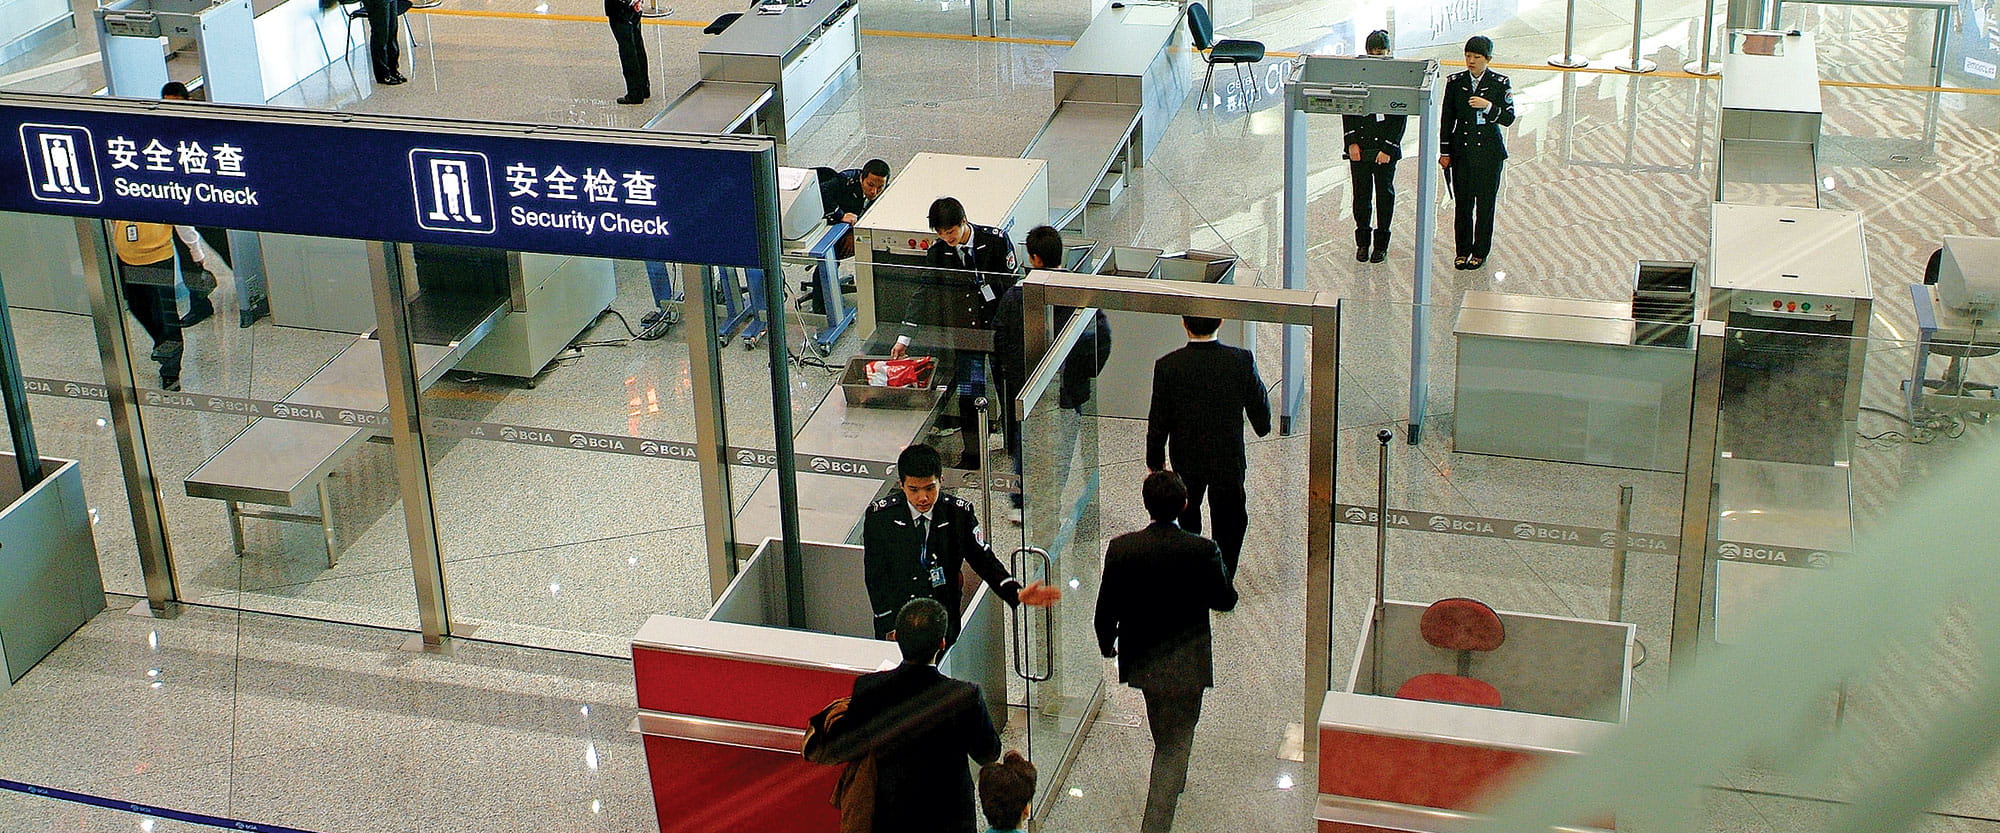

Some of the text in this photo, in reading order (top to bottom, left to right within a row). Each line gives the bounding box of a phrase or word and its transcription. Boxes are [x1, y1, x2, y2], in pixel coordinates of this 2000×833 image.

[106, 136, 247, 178] 安全检查
[114, 178, 260, 206] Security Check
[505, 162, 657, 206] 安全检查
[510, 206, 670, 236] Security Check
[290, 407, 325, 420] BCIA
[518, 431, 696, 458] BCIA BCIA BCIA
[831, 461, 869, 474] BCIA
[1452, 520, 1495, 534] BCIA
[1537, 527, 1580, 541] BCIA
[1742, 549, 1787, 562] BCIA
